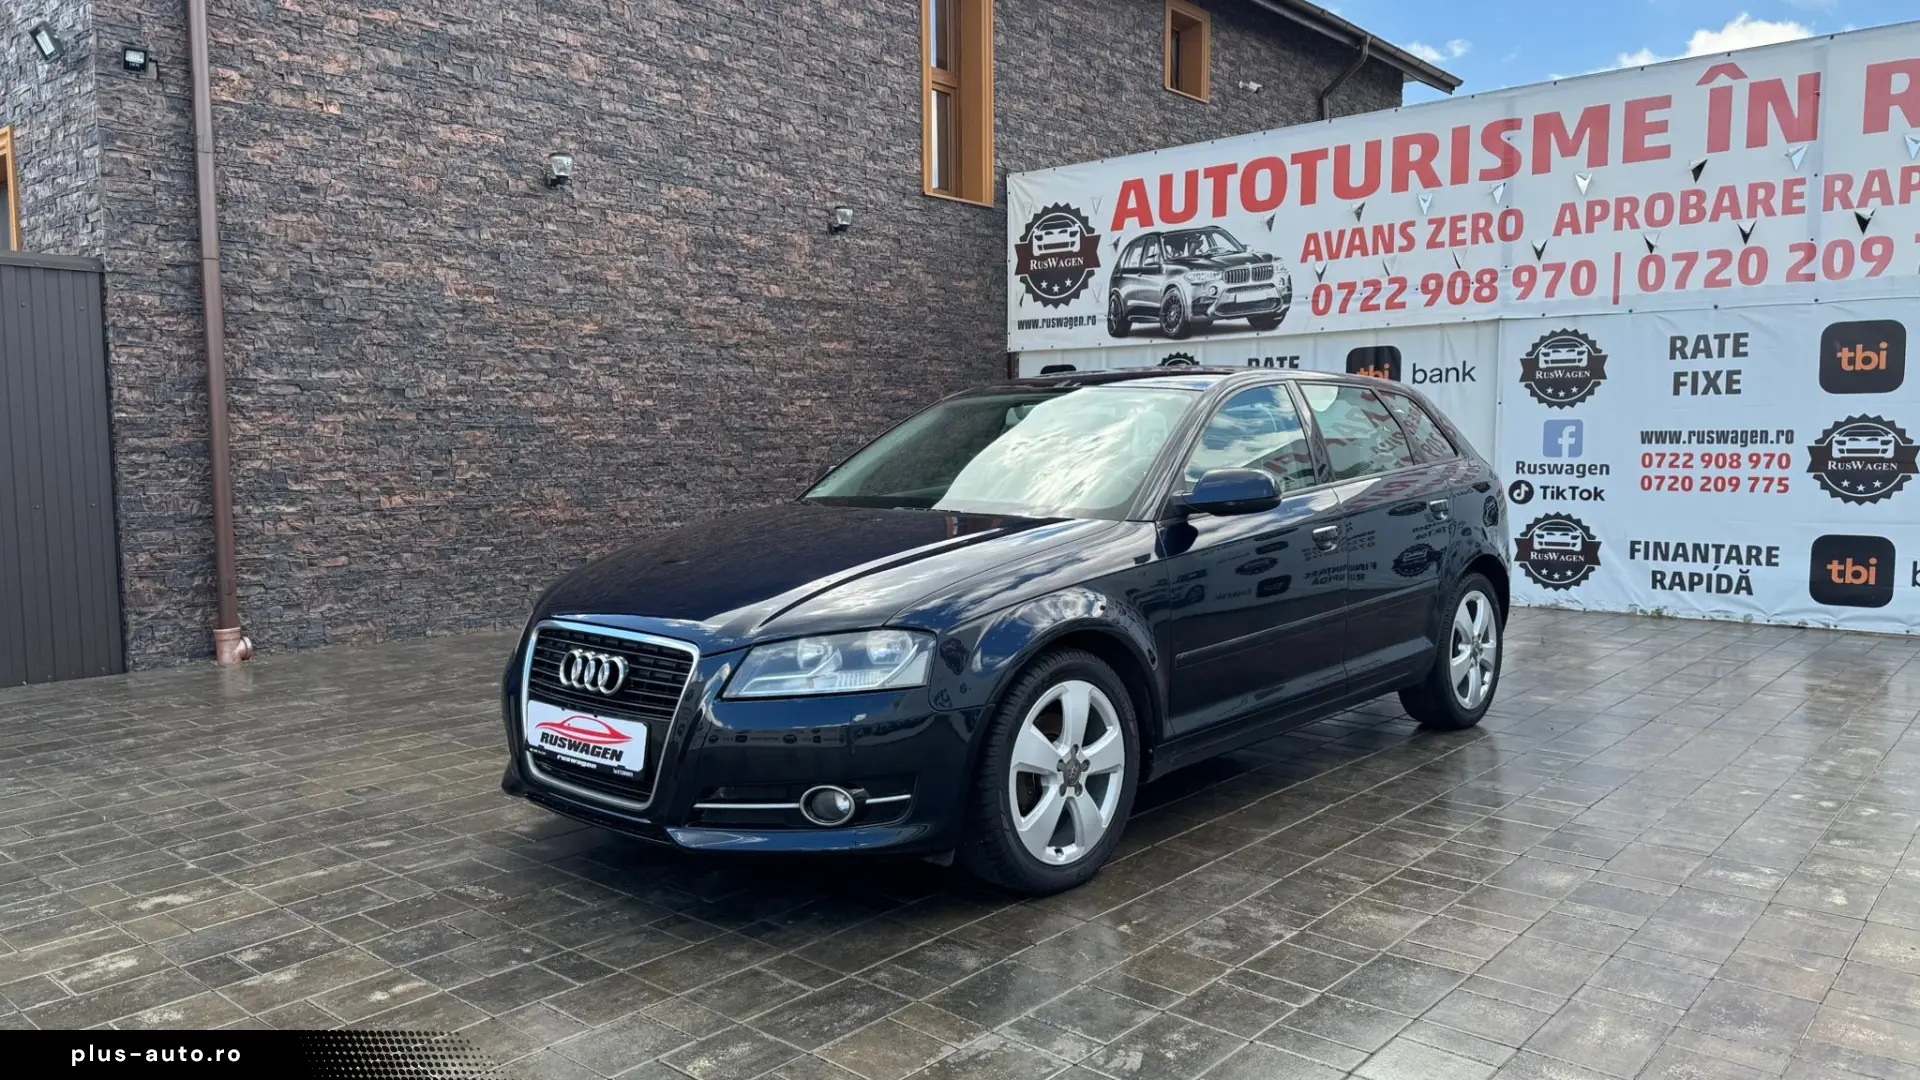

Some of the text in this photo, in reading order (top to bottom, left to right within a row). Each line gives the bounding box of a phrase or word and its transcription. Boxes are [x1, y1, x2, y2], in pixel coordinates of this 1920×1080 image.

[1110, 58, 1920, 231] AUTOTURISME ÎN R
[1300, 165, 1920, 264] AVANS ZERO APROBARE RAP
[1311, 277, 1408, 318] 0722
[1419, 267, 1500, 308] 908
[1511, 259, 1598, 301] 970
[1637, 243, 1769, 293] 0720
[1785, 235, 1895, 283] 209
[1017, 315, 1096, 330] www.ruswagen.ro
[1669, 332, 1749, 361] RATE
[1836, 341, 1889, 372] tbi
[1412, 360, 1476, 385] bank
[1672, 369, 1743, 397] FIXE
[1640, 429, 1795, 449] www.ruswagen.ro
[1515, 460, 1611, 478] Ruswagen
[1641, 453, 1792, 471] 0722 908 970
[1540, 485, 1606, 502] TikTok
[1640, 476, 1790, 494] 0720 209 775
[1629, 540, 1780, 573] FINANȚARE
[1651, 569, 1754, 596] RAPIDĂ
[1826, 557, 1878, 585] tbi
[540, 732, 623, 761] RUSWAGEN
